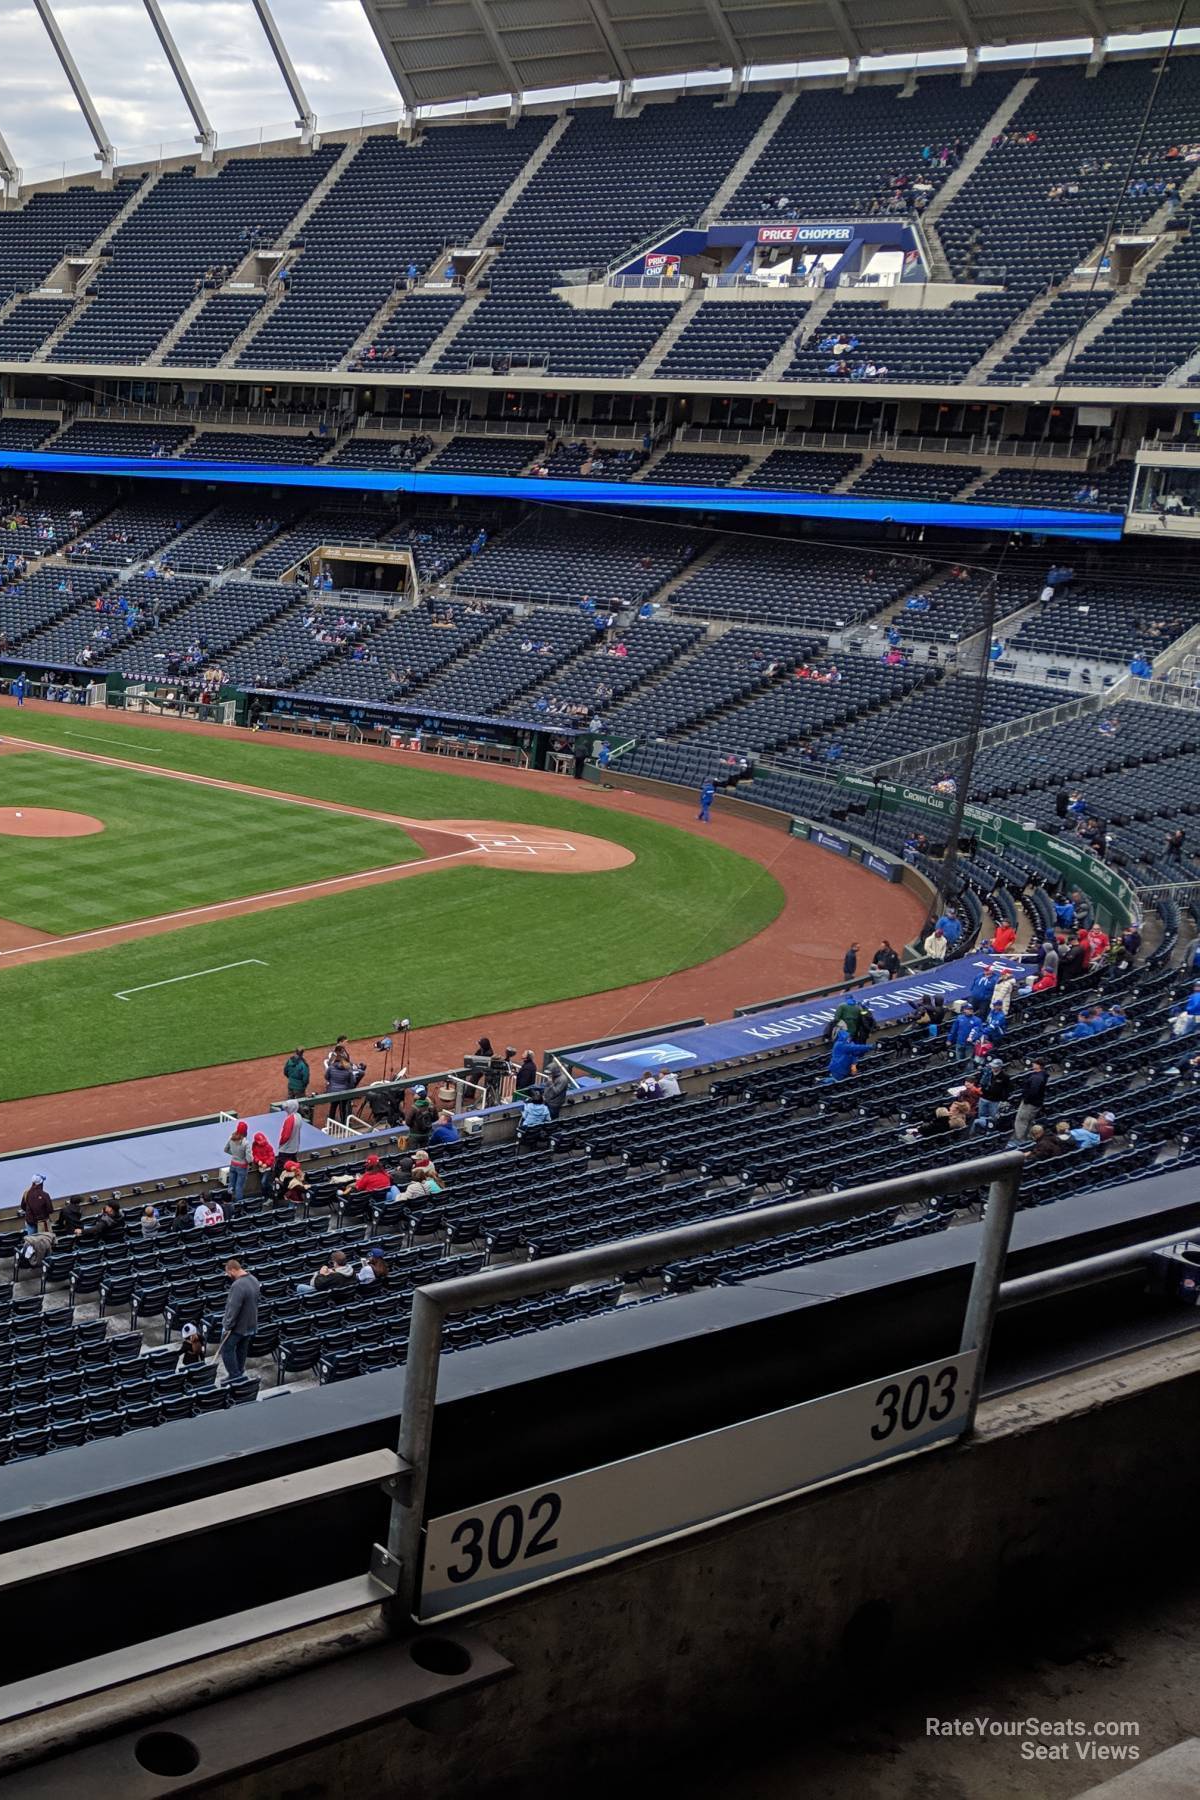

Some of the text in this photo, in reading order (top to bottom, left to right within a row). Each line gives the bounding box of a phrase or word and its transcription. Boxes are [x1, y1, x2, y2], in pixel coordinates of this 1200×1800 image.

[762, 229, 850, 240] PRICE CHOPPER
[903, 789, 944, 809] CROWN CLUB
[870, 1365, 959, 1441] 303
[446, 1492, 563, 1583] 302
